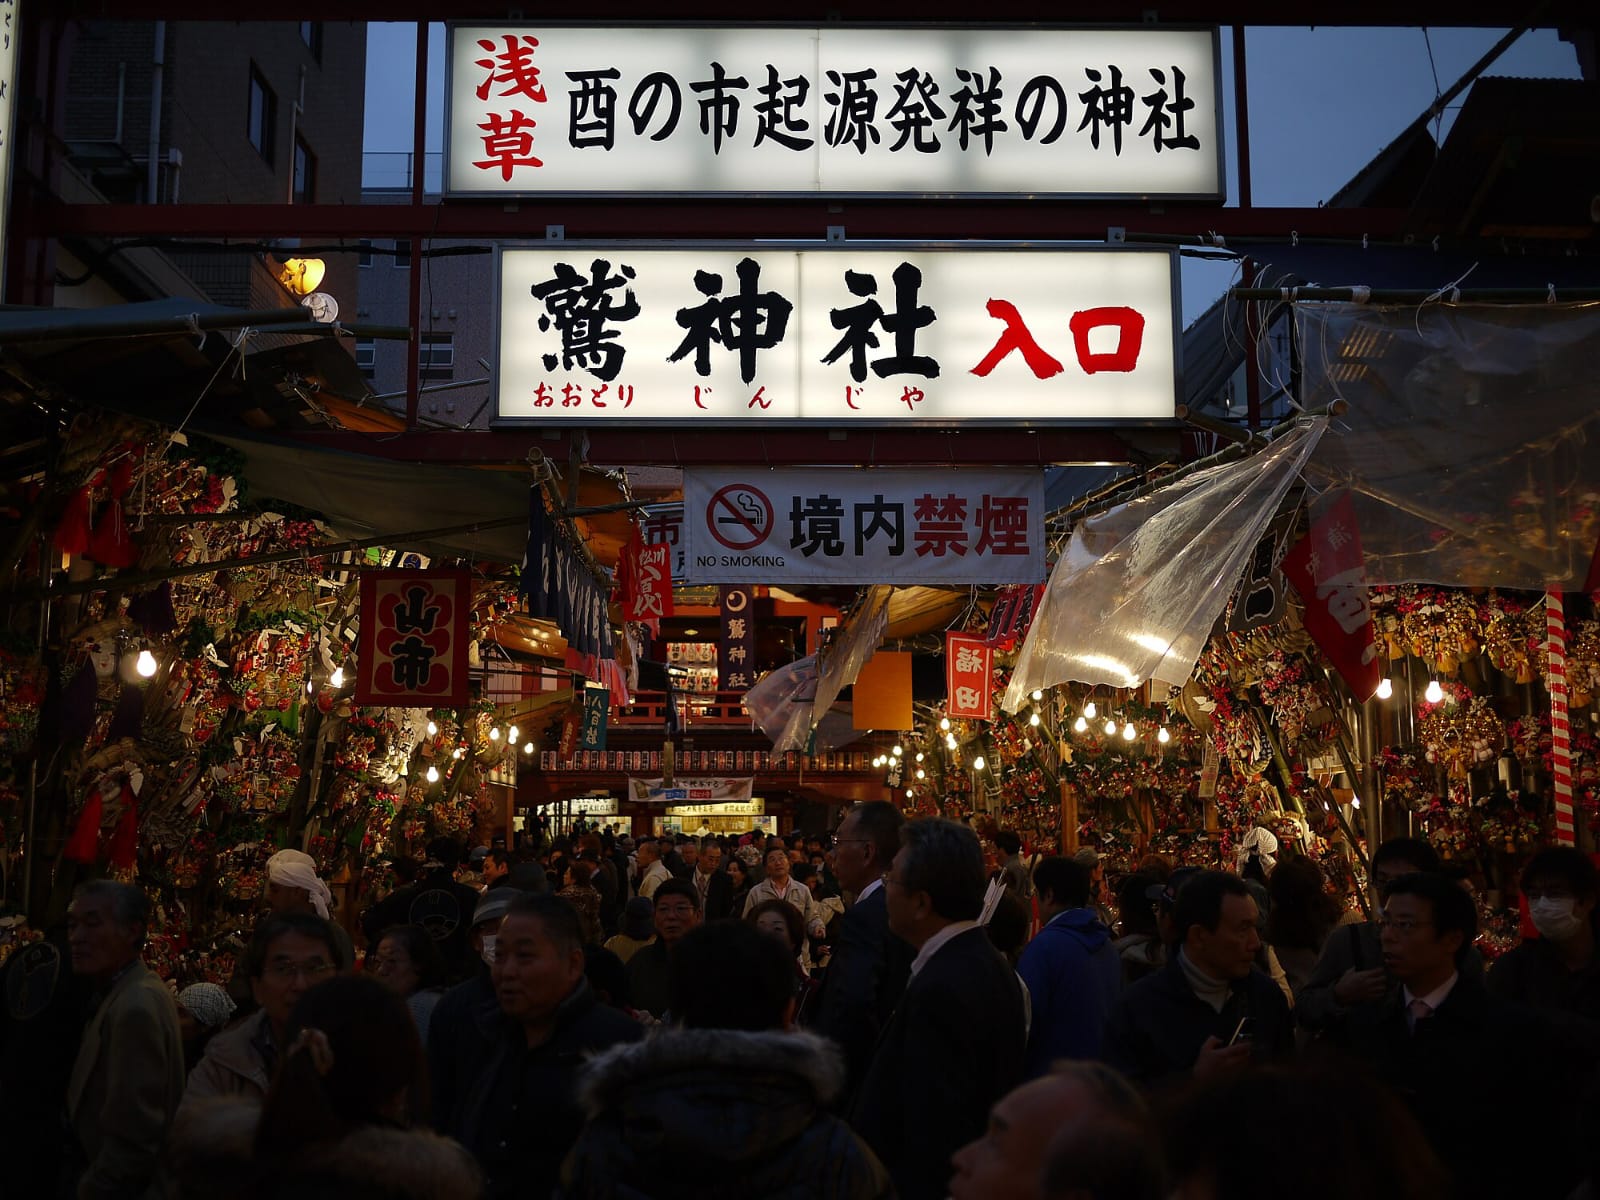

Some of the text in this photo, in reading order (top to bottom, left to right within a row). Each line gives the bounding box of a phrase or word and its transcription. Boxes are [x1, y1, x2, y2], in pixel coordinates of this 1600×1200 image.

[475, 35, 547, 181] 浅草
[565, 62, 1201, 156] 酉の市起源発祥の神社
[531, 258, 1145, 383] 鷲神社 入口
[534, 383, 634, 408] おおとり
[697, 555, 717, 567] NO
[720, 555, 785, 567] SMOKING
[790, 494, 1030, 557] 境内禁煙
[389, 586, 441, 690] 山市
[728, 618, 749, 688] 鷲神社
